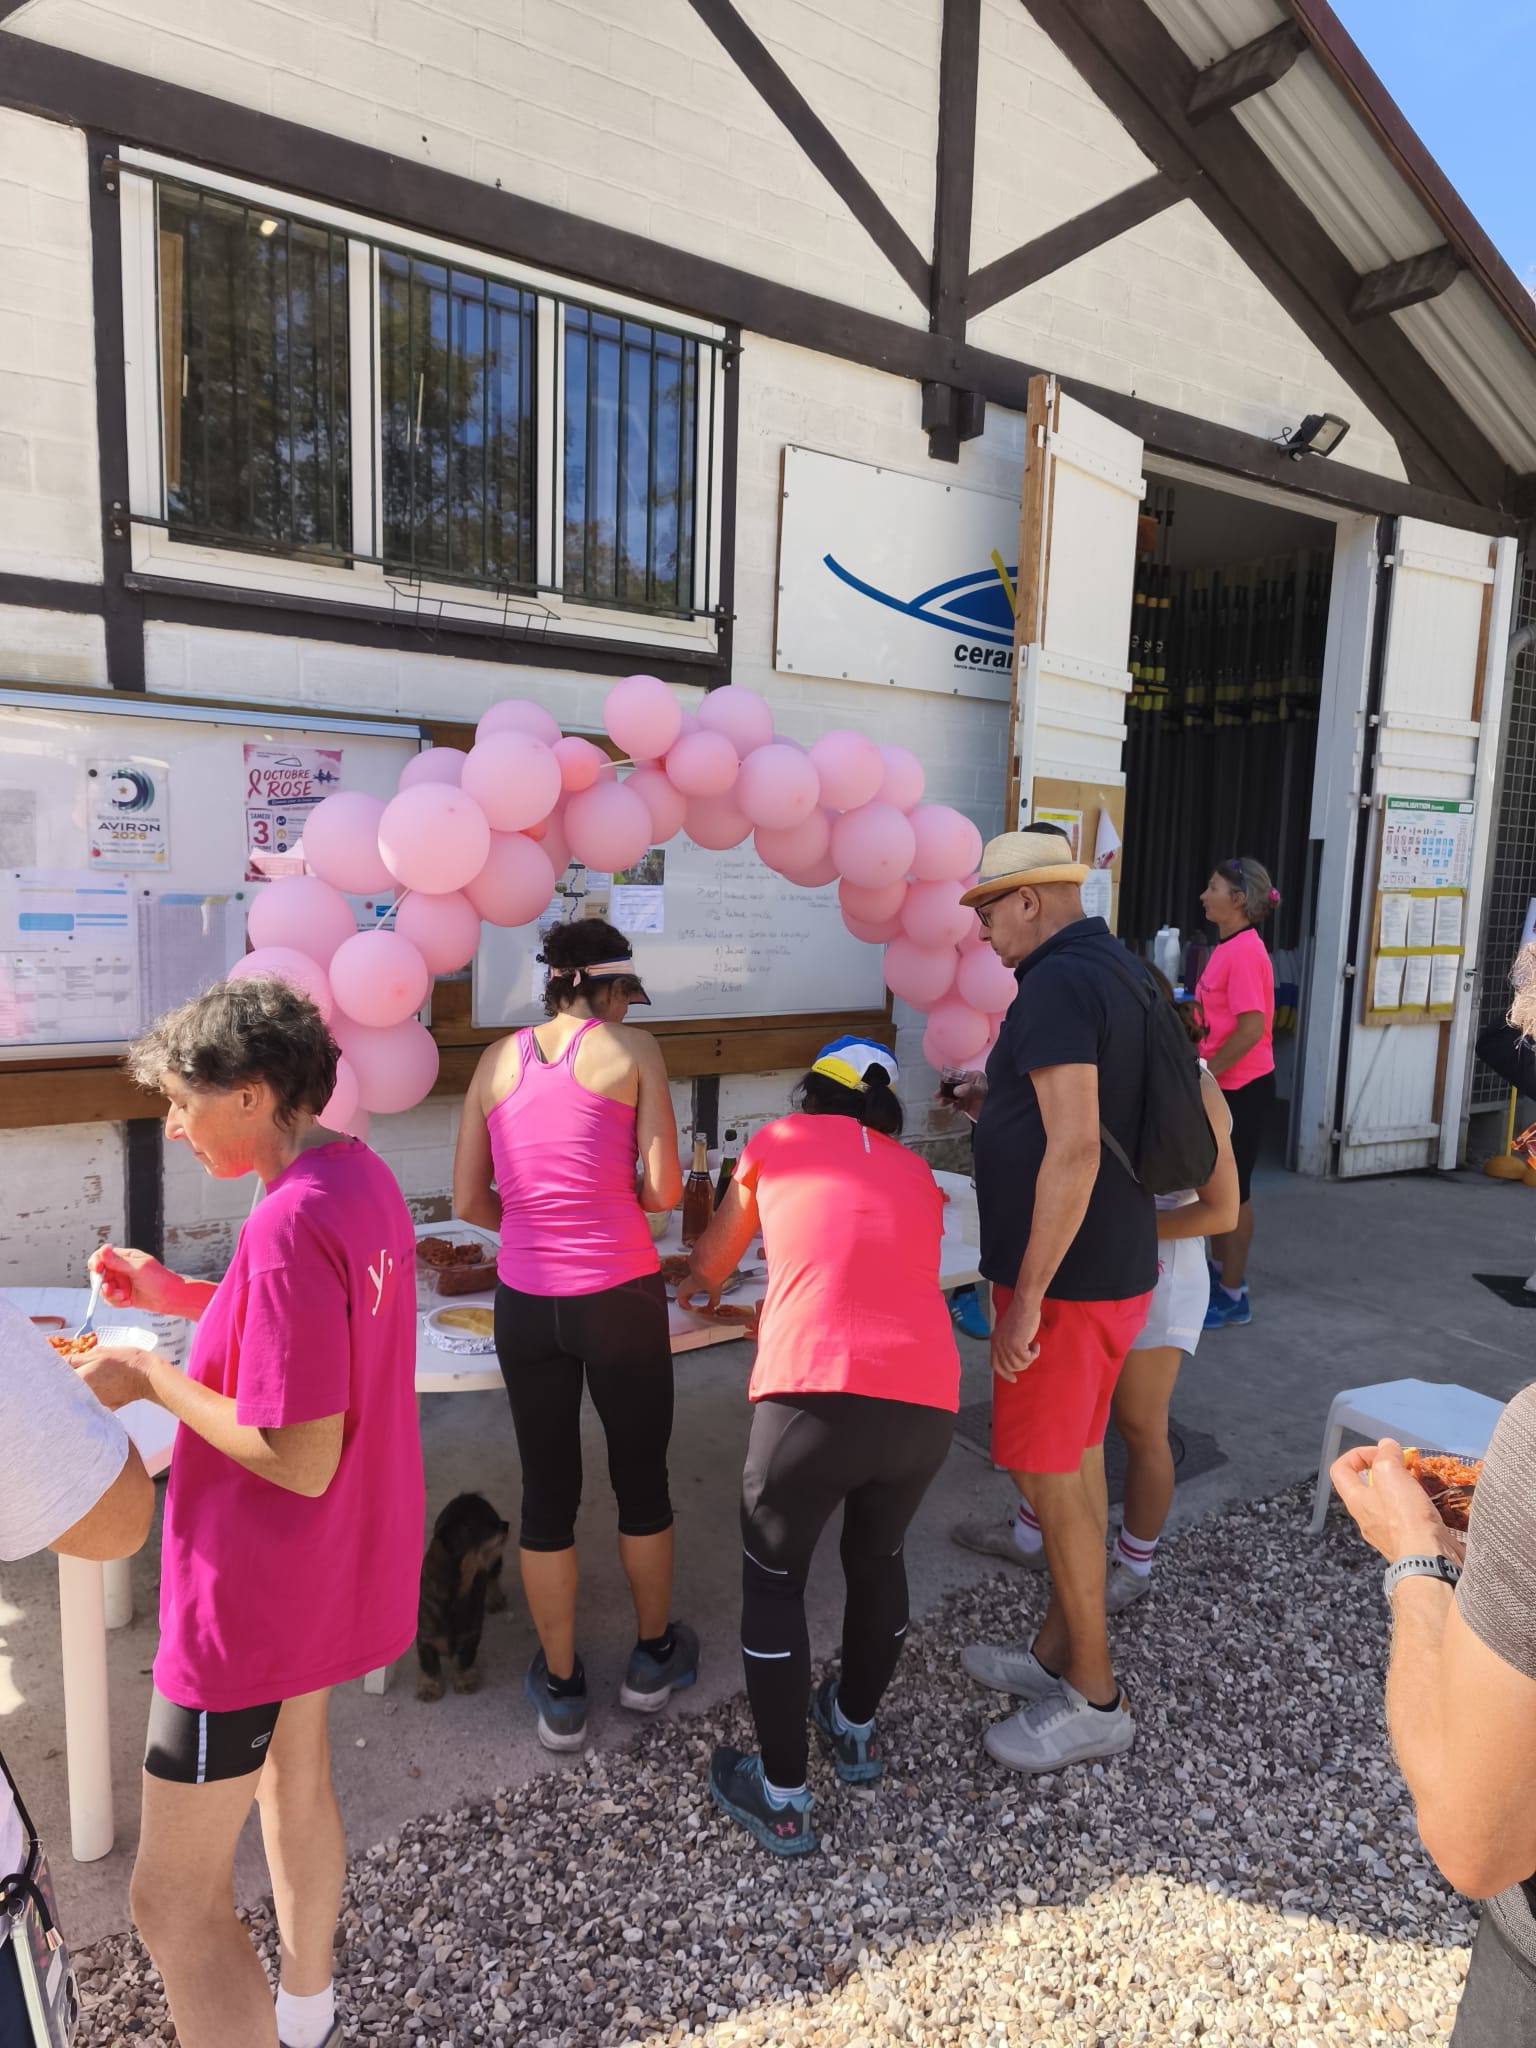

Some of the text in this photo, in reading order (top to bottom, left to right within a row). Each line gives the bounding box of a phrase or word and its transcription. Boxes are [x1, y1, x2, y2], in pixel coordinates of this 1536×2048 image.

[263, 769, 311, 781] OCTOBRE
[267, 780, 314, 798] ROSE
[98, 822, 161, 832] AVIRON
[253, 820, 269, 844] 3
